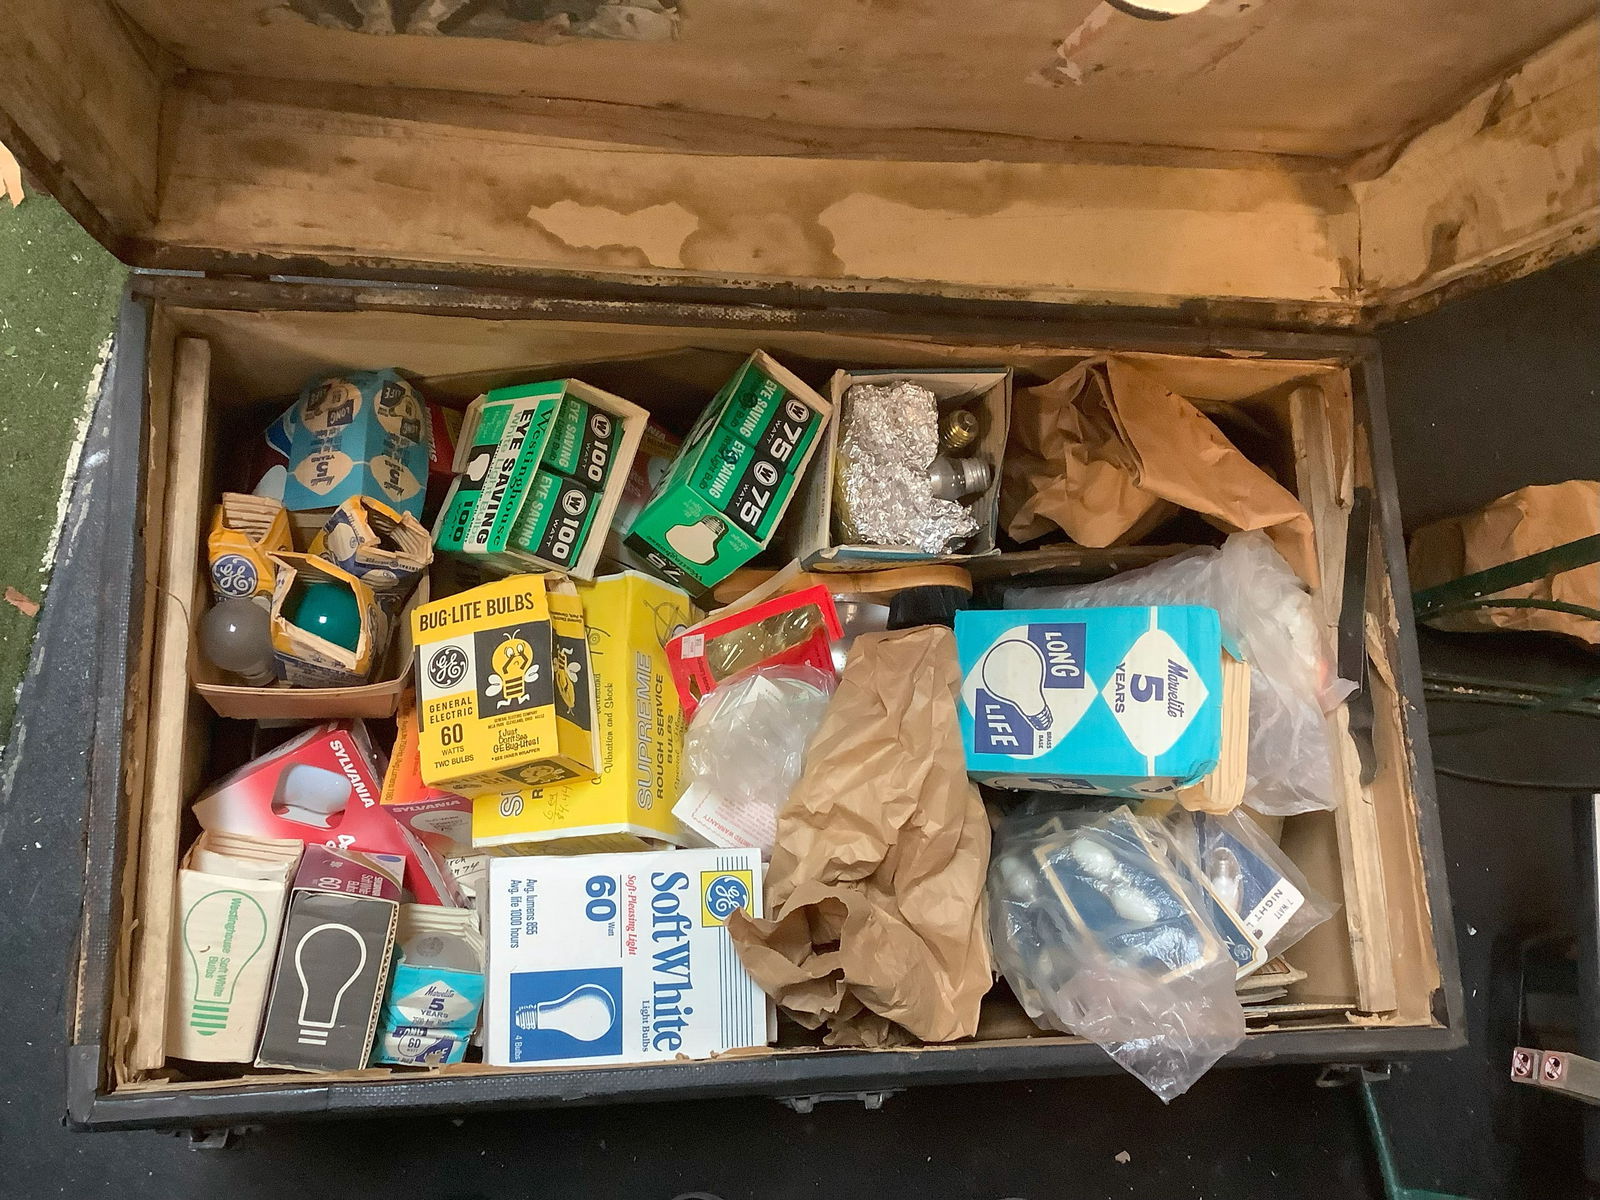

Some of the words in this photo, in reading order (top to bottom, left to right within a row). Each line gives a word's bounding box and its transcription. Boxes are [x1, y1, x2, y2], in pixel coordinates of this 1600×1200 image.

[761, 379, 778, 400] EYE
[329, 407, 351, 424] LONG
[569, 400, 581, 419] EYE
[740, 399, 768, 438] SAVING
[500, 410, 523, 451] White
[509, 408, 535, 451] EYE
[766, 419, 782, 445] WATT
[770, 422, 803, 462] 75
[559, 423, 577, 468] SAVING
[582, 442, 592, 469] WATT
[316, 462, 329, 477] 5
[587, 440, 608, 482] 100
[486, 457, 505, 495] Light
[493, 408, 554, 546] Westinghouse
[536, 475, 553, 500] EYE
[708, 460, 735, 500] SAVING
[476, 457, 516, 545] SAVING
[735, 483, 751, 508] WATT
[739, 485, 771, 527] 75
[453, 502, 472, 542] 100
[467, 499, 489, 545] Bulbs
[518, 500, 543, 547] SAVING
[546, 518, 560, 547] WATT
[552, 518, 580, 560] 100
[646, 534, 703, 582] Westinghouse
[647, 551, 682, 584] 75
[486, 592, 535, 616] BULBS
[1044, 632, 1081, 678] LONG
[603, 683, 614, 709] Shock
[1114, 662, 1127, 714] YEARS
[1130, 673, 1165, 703] 5
[1167, 658, 1190, 719] Marvelite
[429, 696, 473, 713] GENERAL
[429, 706, 474, 724] ELECTRIC
[655, 673, 664, 737] SERVICE
[502, 728, 518, 738] Just
[603, 712, 613, 728] and
[636, 651, 653, 810] SUPREME
[984, 704, 1020, 748] LIFE
[441, 723, 464, 746] 60
[493, 743, 505, 754] GE
[505, 737, 540, 751] Bug-Lites!
[515, 734, 529, 742] See
[434, 759, 450, 769] TWO
[451, 755, 475, 766] BULBS
[441, 746, 465, 756] WATTS
[519, 748, 541, 757] WRAPPER
[604, 731, 615, 774] Vibration
[329, 739, 375, 808] SYLVANIA
[656, 741, 665, 800] ROUGH
[392, 800, 460, 813] SYLVANIA
[703, 815, 735, 838] WARRANTY
[337, 834, 357, 850] 4
[318, 877, 343, 890] 60
[509, 879, 522, 894] Avg.
[525, 878, 538, 894] Avg.
[511, 896, 522, 908] life
[526, 894, 538, 920] lumens
[585, 874, 617, 923] 60
[624, 874, 637, 933] Soft-Pleasing
[650, 871, 693, 944] Soft
[1254, 889, 1283, 922] NIGHT
[222, 897, 242, 954] Westinghouse
[511, 908, 522, 929] 1000
[526, 920, 538, 936] 855
[607, 921, 615, 937] Watt
[510, 929, 520, 949] hours
[624, 934, 637, 957] Light
[204, 956, 219, 979] Bulbs
[219, 957, 231, 973] Soft
[213, 974, 228, 998] White
[424, 986, 455, 998] Marvelite
[652, 940, 694, 1052] White
[420, 1009, 449, 1019] YEARS
[428, 998, 445, 1011] 5
[641, 1000, 650, 1025] Light
[408, 1038, 421, 1049] 60
[514, 1041, 523, 1061] Bulbs
[641, 1025, 649, 1053] Bulbs
